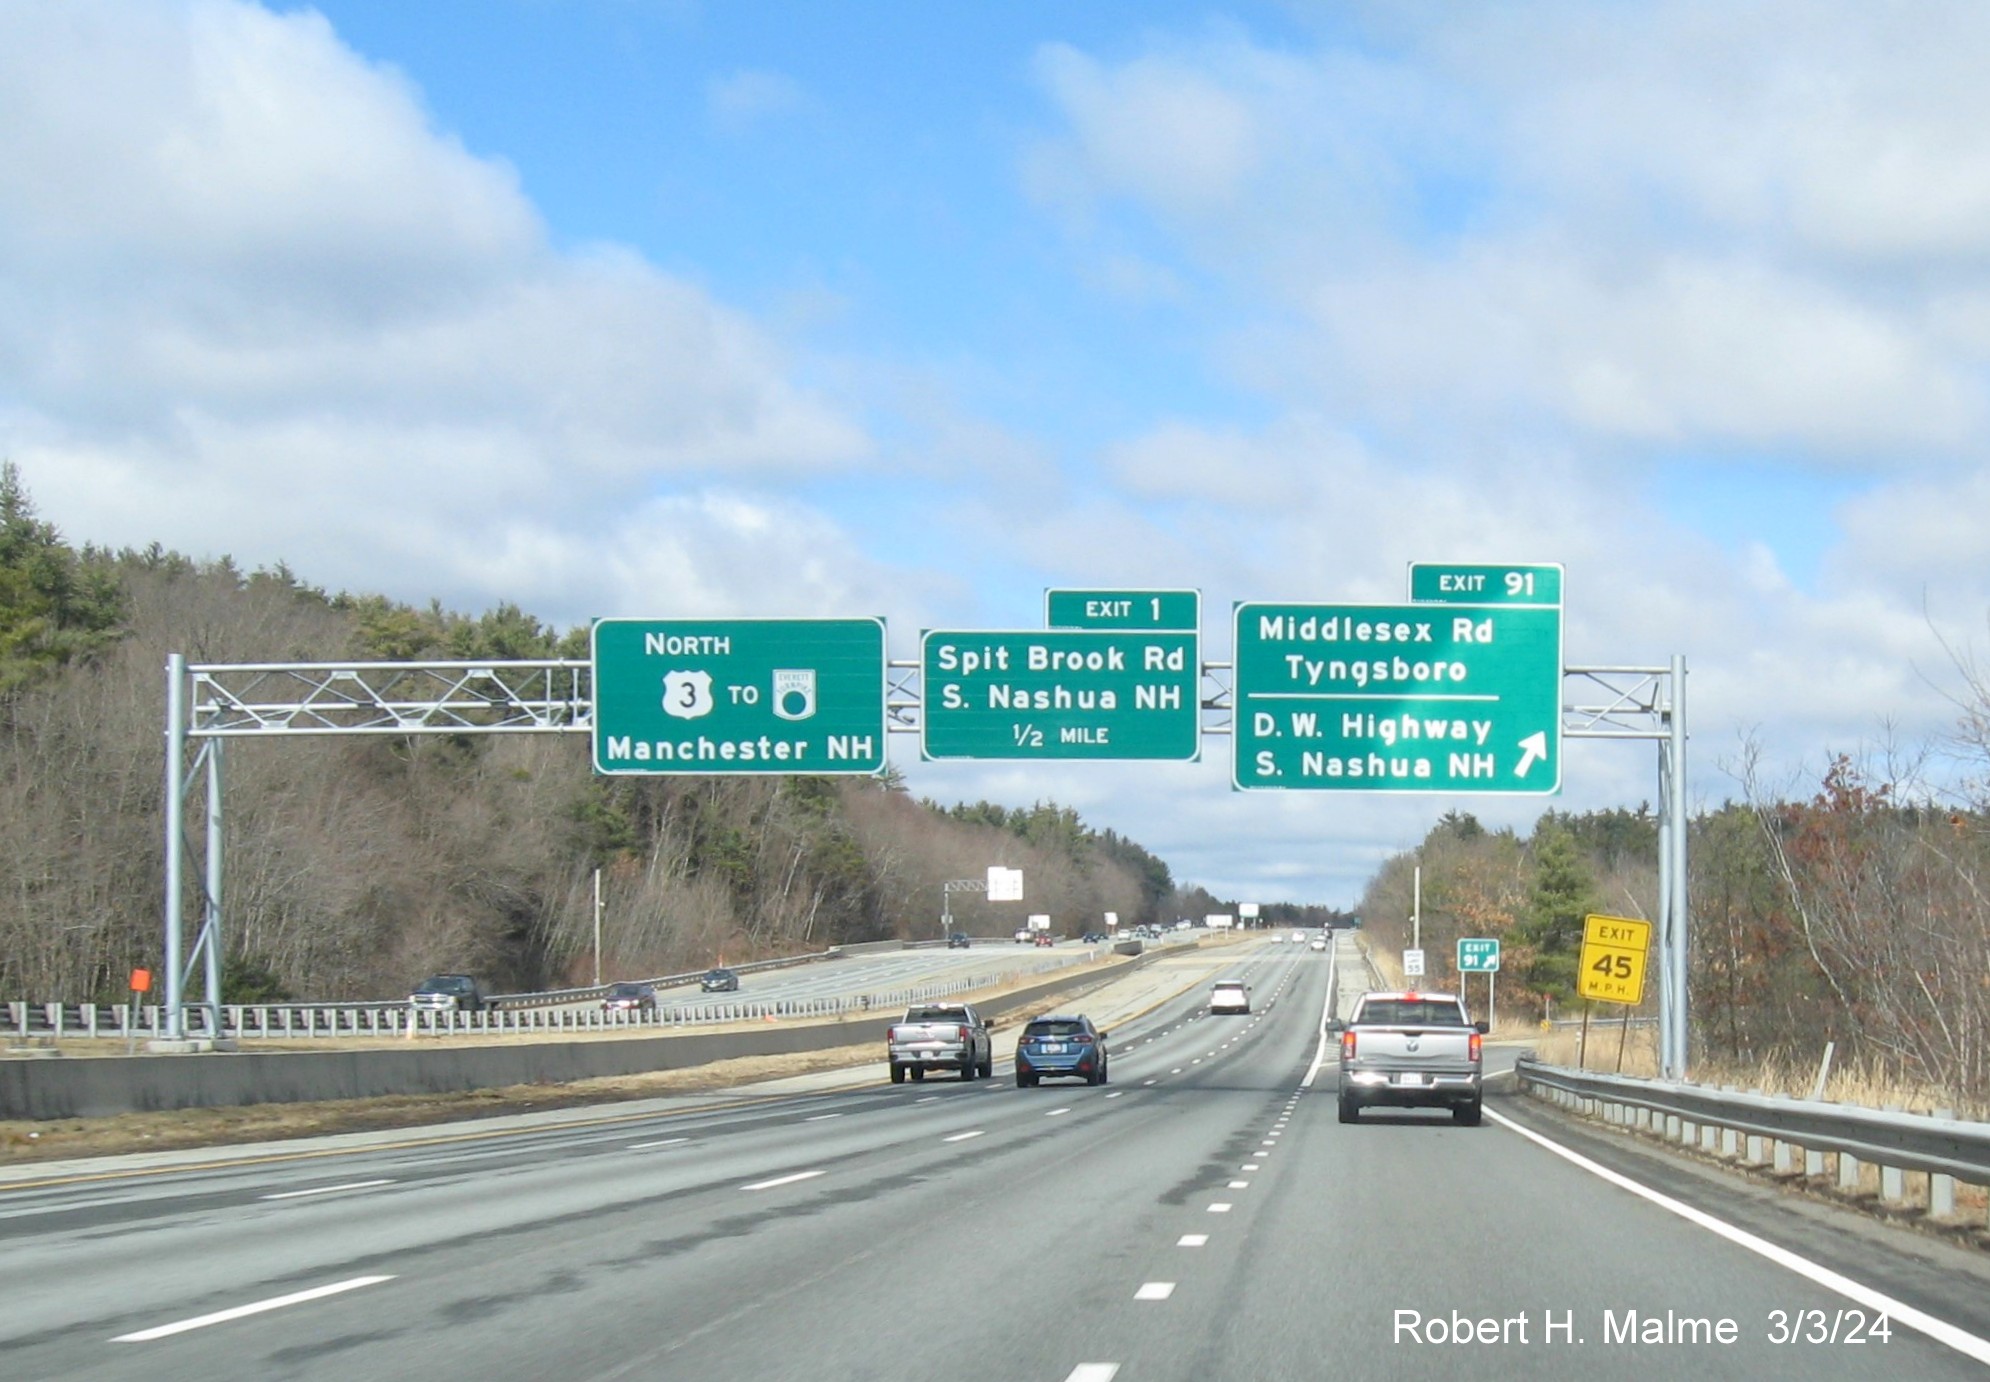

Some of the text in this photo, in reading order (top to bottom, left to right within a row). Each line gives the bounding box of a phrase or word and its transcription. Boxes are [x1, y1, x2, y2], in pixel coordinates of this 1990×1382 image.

[1440, 572, 1534, 595] EXIT 91
[1087, 598, 1159, 620] EXIT 1
[1260, 616, 1492, 643] Middlesex Rd
[939, 645, 1183, 675] Spit Brook Rd
[1286, 655, 1467, 687] Tyngsboro
[679, 681, 696, 708] 3
[728, 686, 758, 704] TO
[943, 684, 1179, 709] S. Nashua NH
[1061, 728, 1108, 743] MILE
[1255, 713, 1491, 746] D. W. Highway
[608, 736, 872, 760] Manchester NH
[1257, 751, 1494, 778] S. Nashua NH
[1599, 926, 1634, 941] EXIT
[1465, 943, 1490, 952] EXIT
[1463, 954, 1479, 967] 91
[1592, 954, 1632, 979] 45
